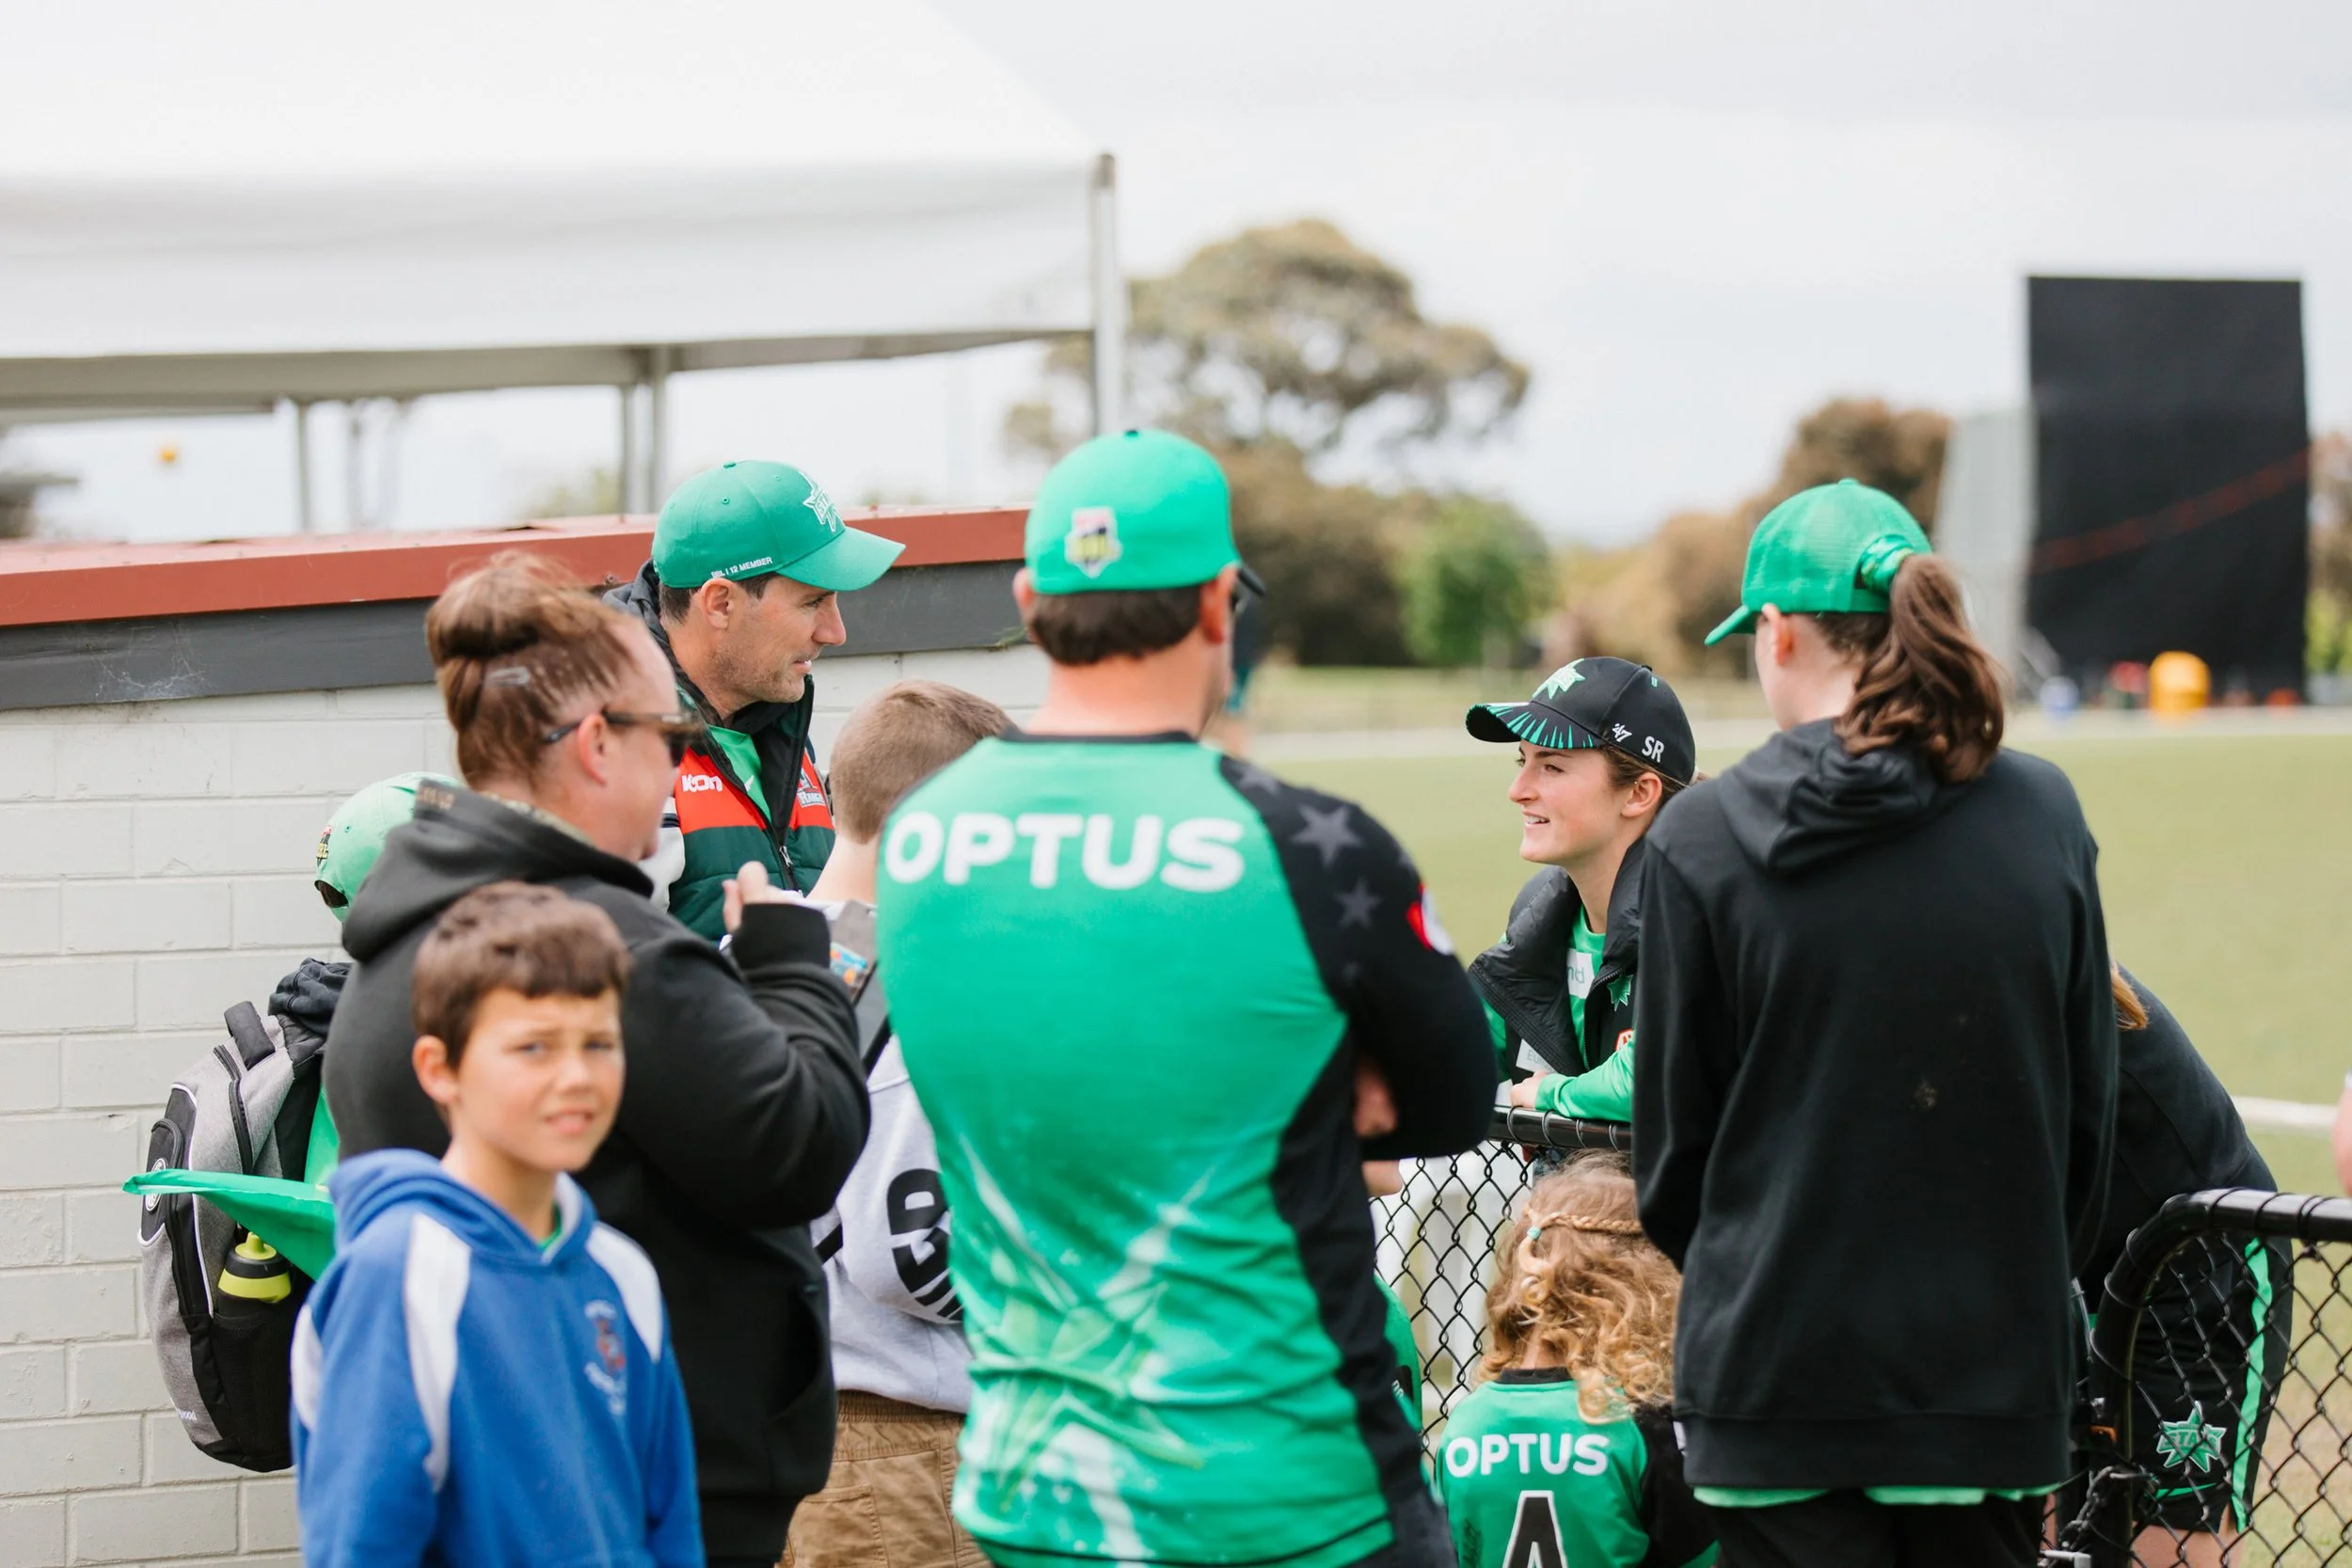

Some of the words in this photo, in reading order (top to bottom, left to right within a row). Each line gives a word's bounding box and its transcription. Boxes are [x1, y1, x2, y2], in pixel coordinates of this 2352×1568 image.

[739, 556, 773, 571] MEMBER
[1642, 736, 1664, 763] SR
[884, 811, 1246, 894] OPTUS
[1445, 1432, 1610, 1478] OPTUS
